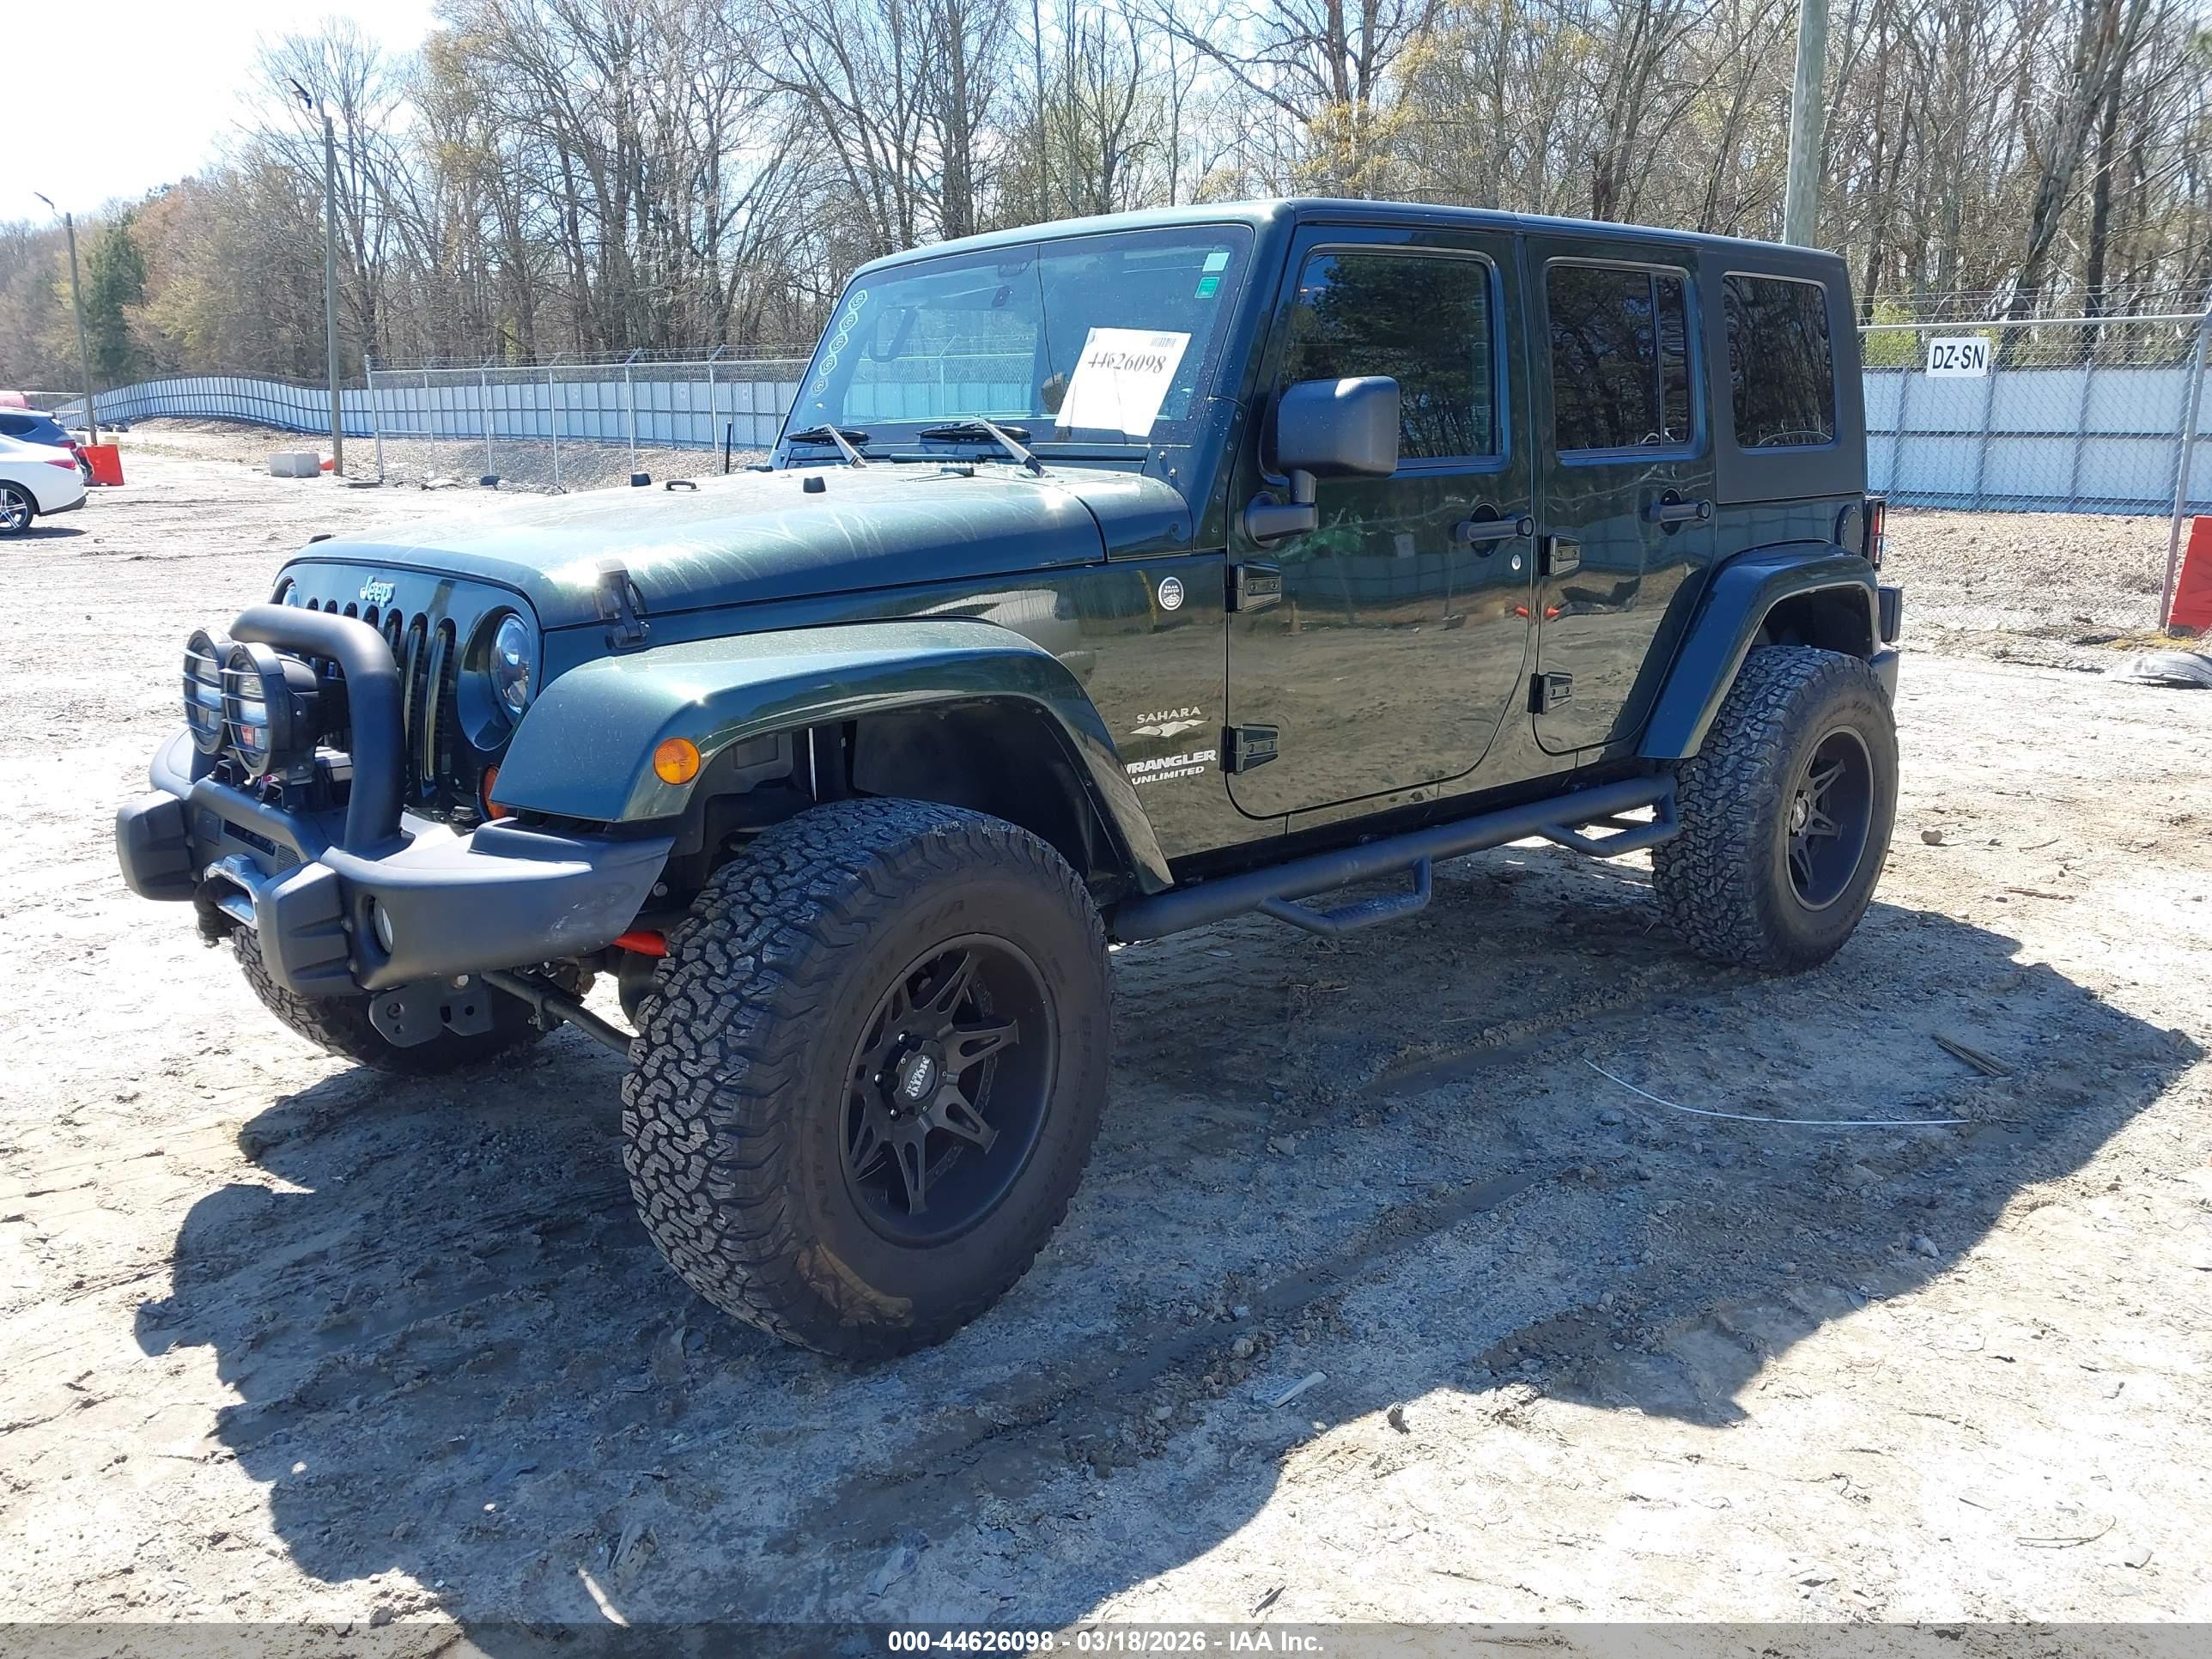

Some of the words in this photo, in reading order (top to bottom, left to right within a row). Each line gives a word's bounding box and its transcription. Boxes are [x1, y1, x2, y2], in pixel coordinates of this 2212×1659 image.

[1088, 351, 1167, 374] 44626098
[1932, 344, 1984, 369] DZ-SN
[360, 575, 394, 608] Jeep
[1136, 706, 1201, 724] SAHARA
[1132, 766, 1205, 785] UNLIMITED
